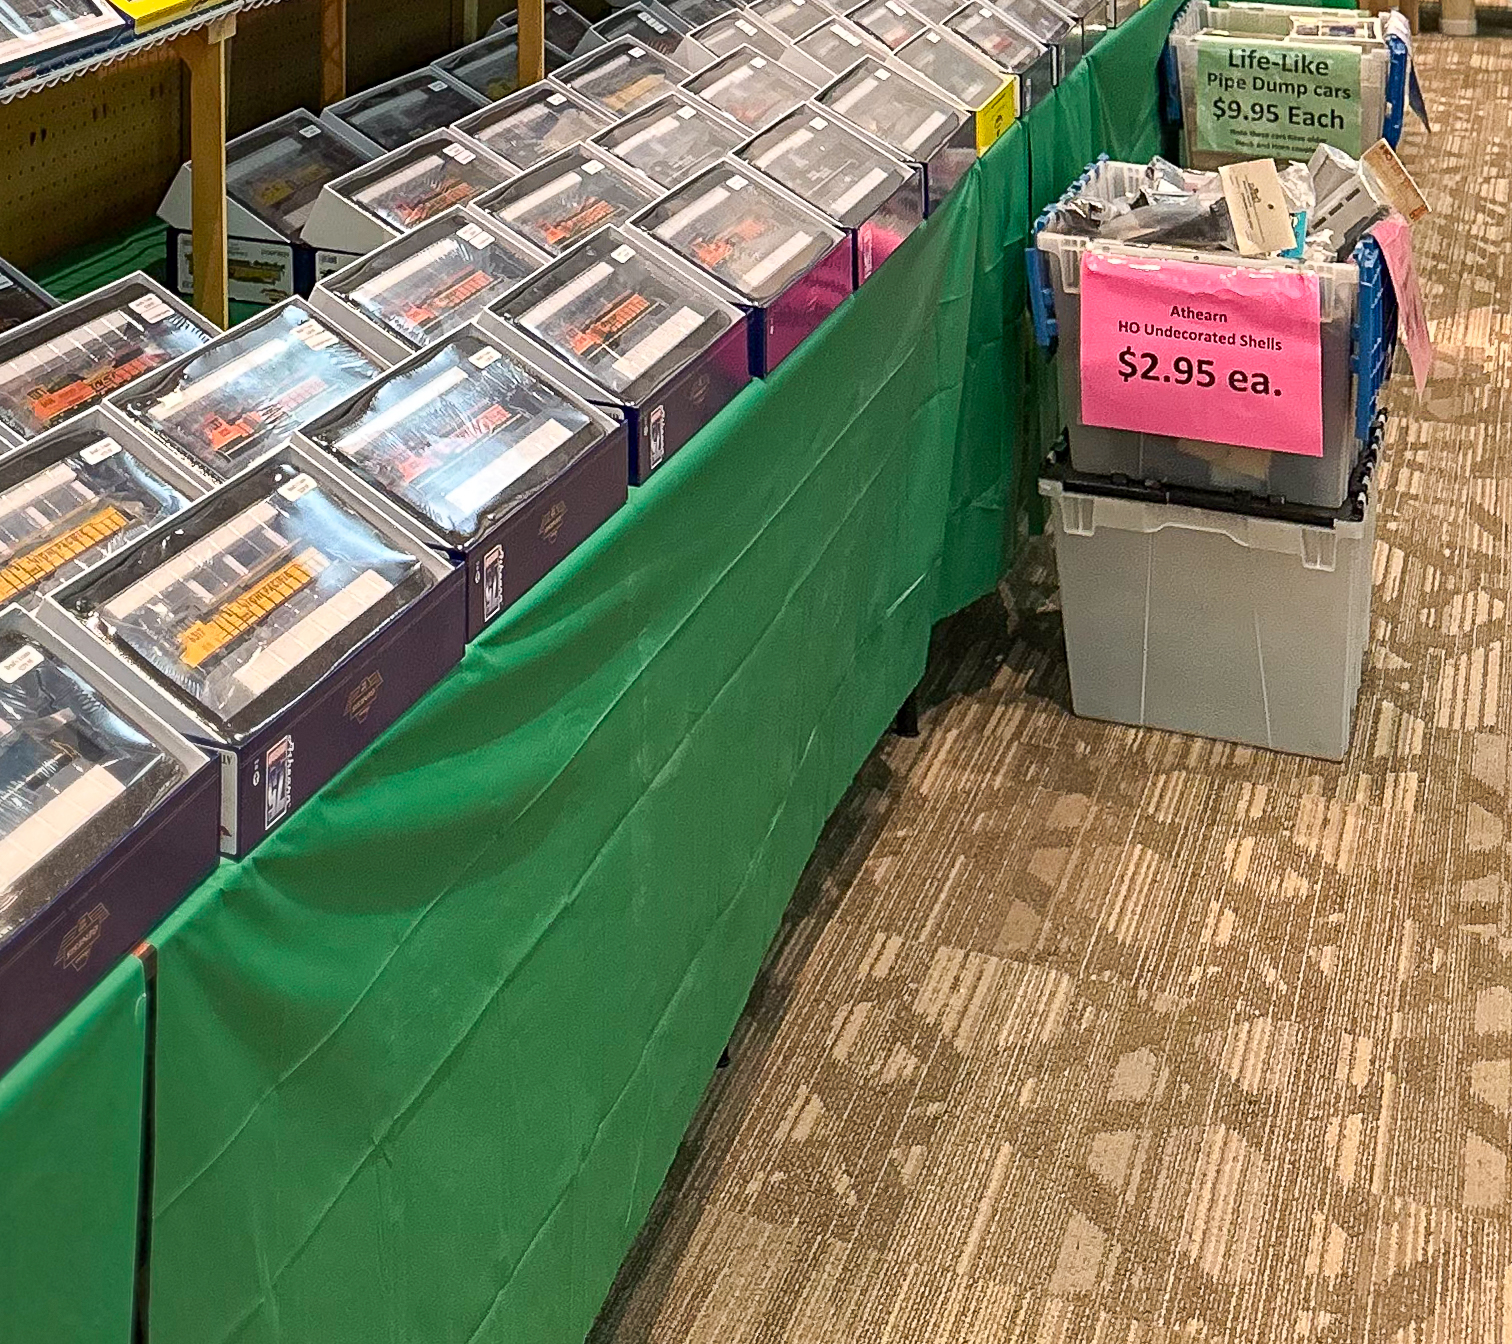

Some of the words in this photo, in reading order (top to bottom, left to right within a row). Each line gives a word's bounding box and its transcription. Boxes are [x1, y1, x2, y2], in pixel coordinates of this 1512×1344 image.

[1228, 48, 1329, 76] Life-Like
[1208, 72, 1247, 91] Pipe
[1253, 76, 1308, 98] Dump
[1314, 85, 1351, 99] cars
[1213, 96, 1279, 122] $9.95
[1289, 106, 1344, 129] Each
[1170, 305, 1228, 323] Athearn
[1118, 320, 1140, 334] HO
[1144, 323, 1236, 345] Undecorated
[1240, 334, 1282, 351] Shells
[1118, 346, 1216, 387] $2.95
[1228, 369, 1281, 396] ea.
